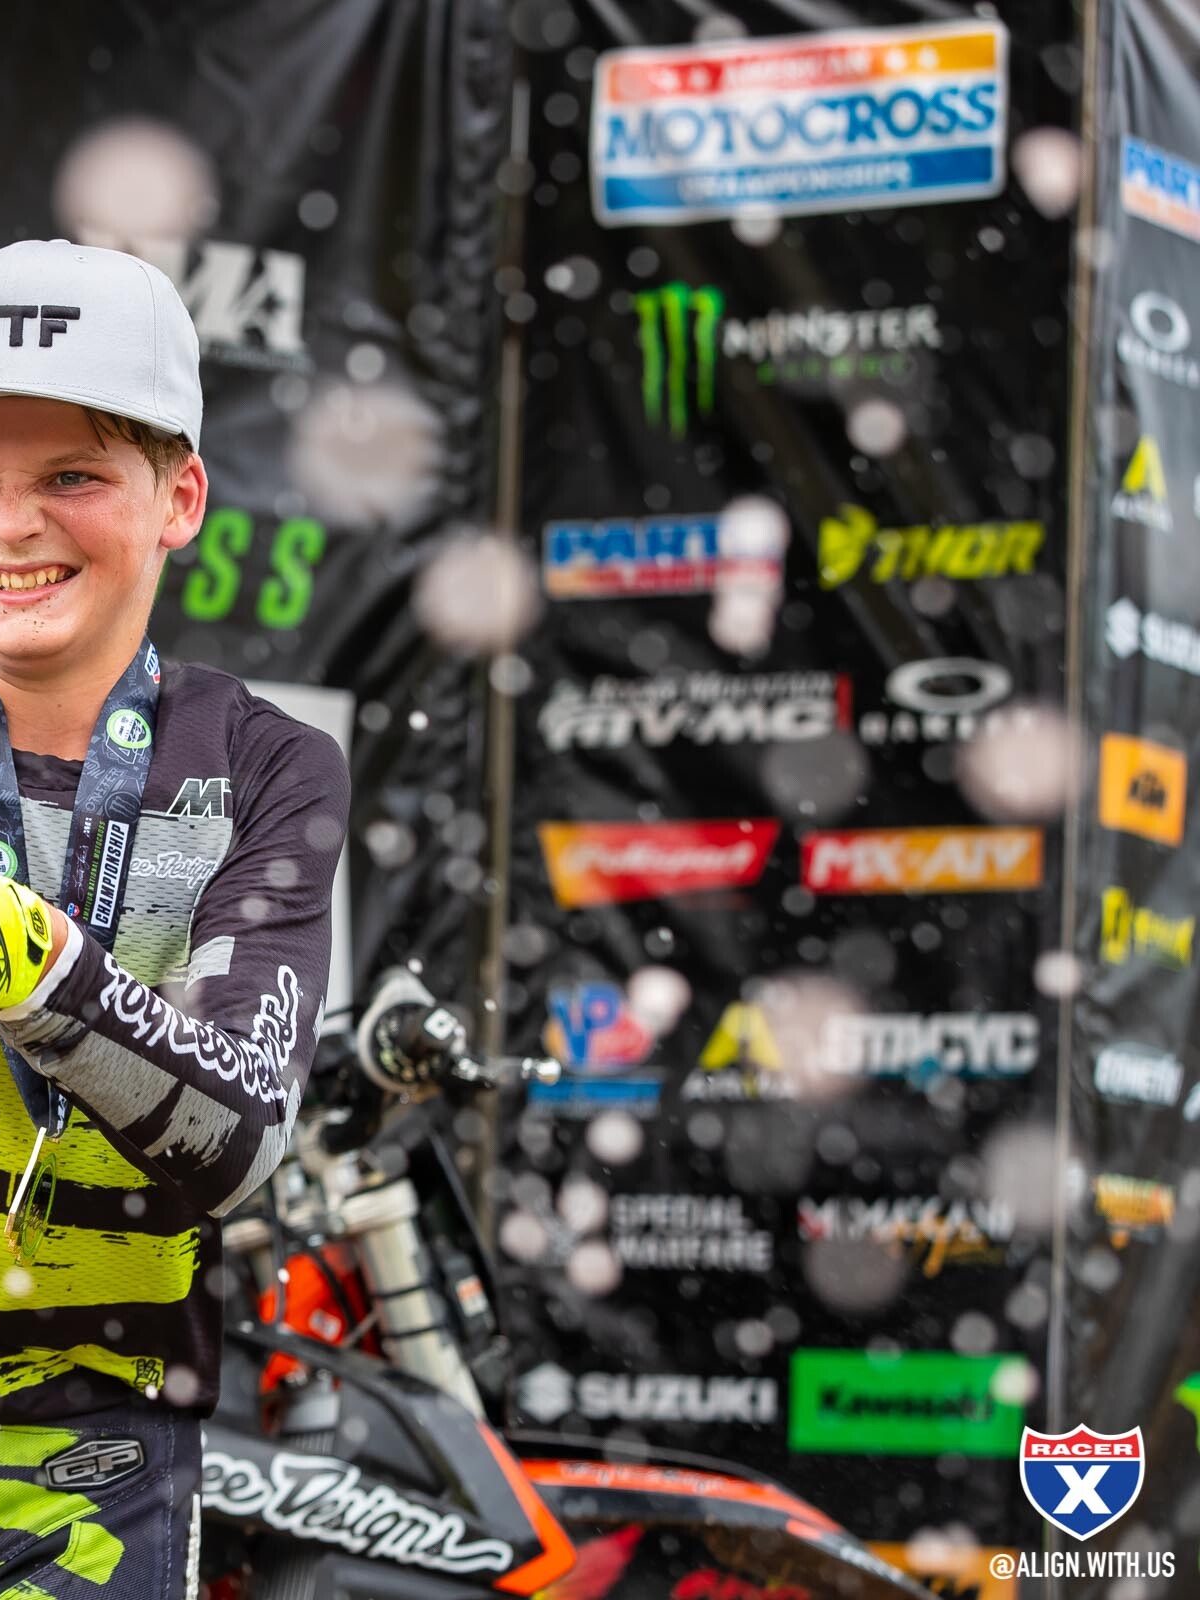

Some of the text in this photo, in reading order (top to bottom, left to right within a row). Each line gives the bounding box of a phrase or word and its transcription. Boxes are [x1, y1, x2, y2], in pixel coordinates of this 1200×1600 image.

[606, 83, 997, 161] MOTOCROSS
[550, 520, 778, 564] PART
[872, 520, 1046, 582] THOR
[858, 711, 1040, 746] OAKL
[95, 823, 126, 925] CHAMPIONSHIP
[576, 1372, 779, 1423] SUZUKI
[53, 1448, 141, 1481] GP
[202, 1451, 269, 1514] ee
[264, 1452, 514, 1573] Designs
